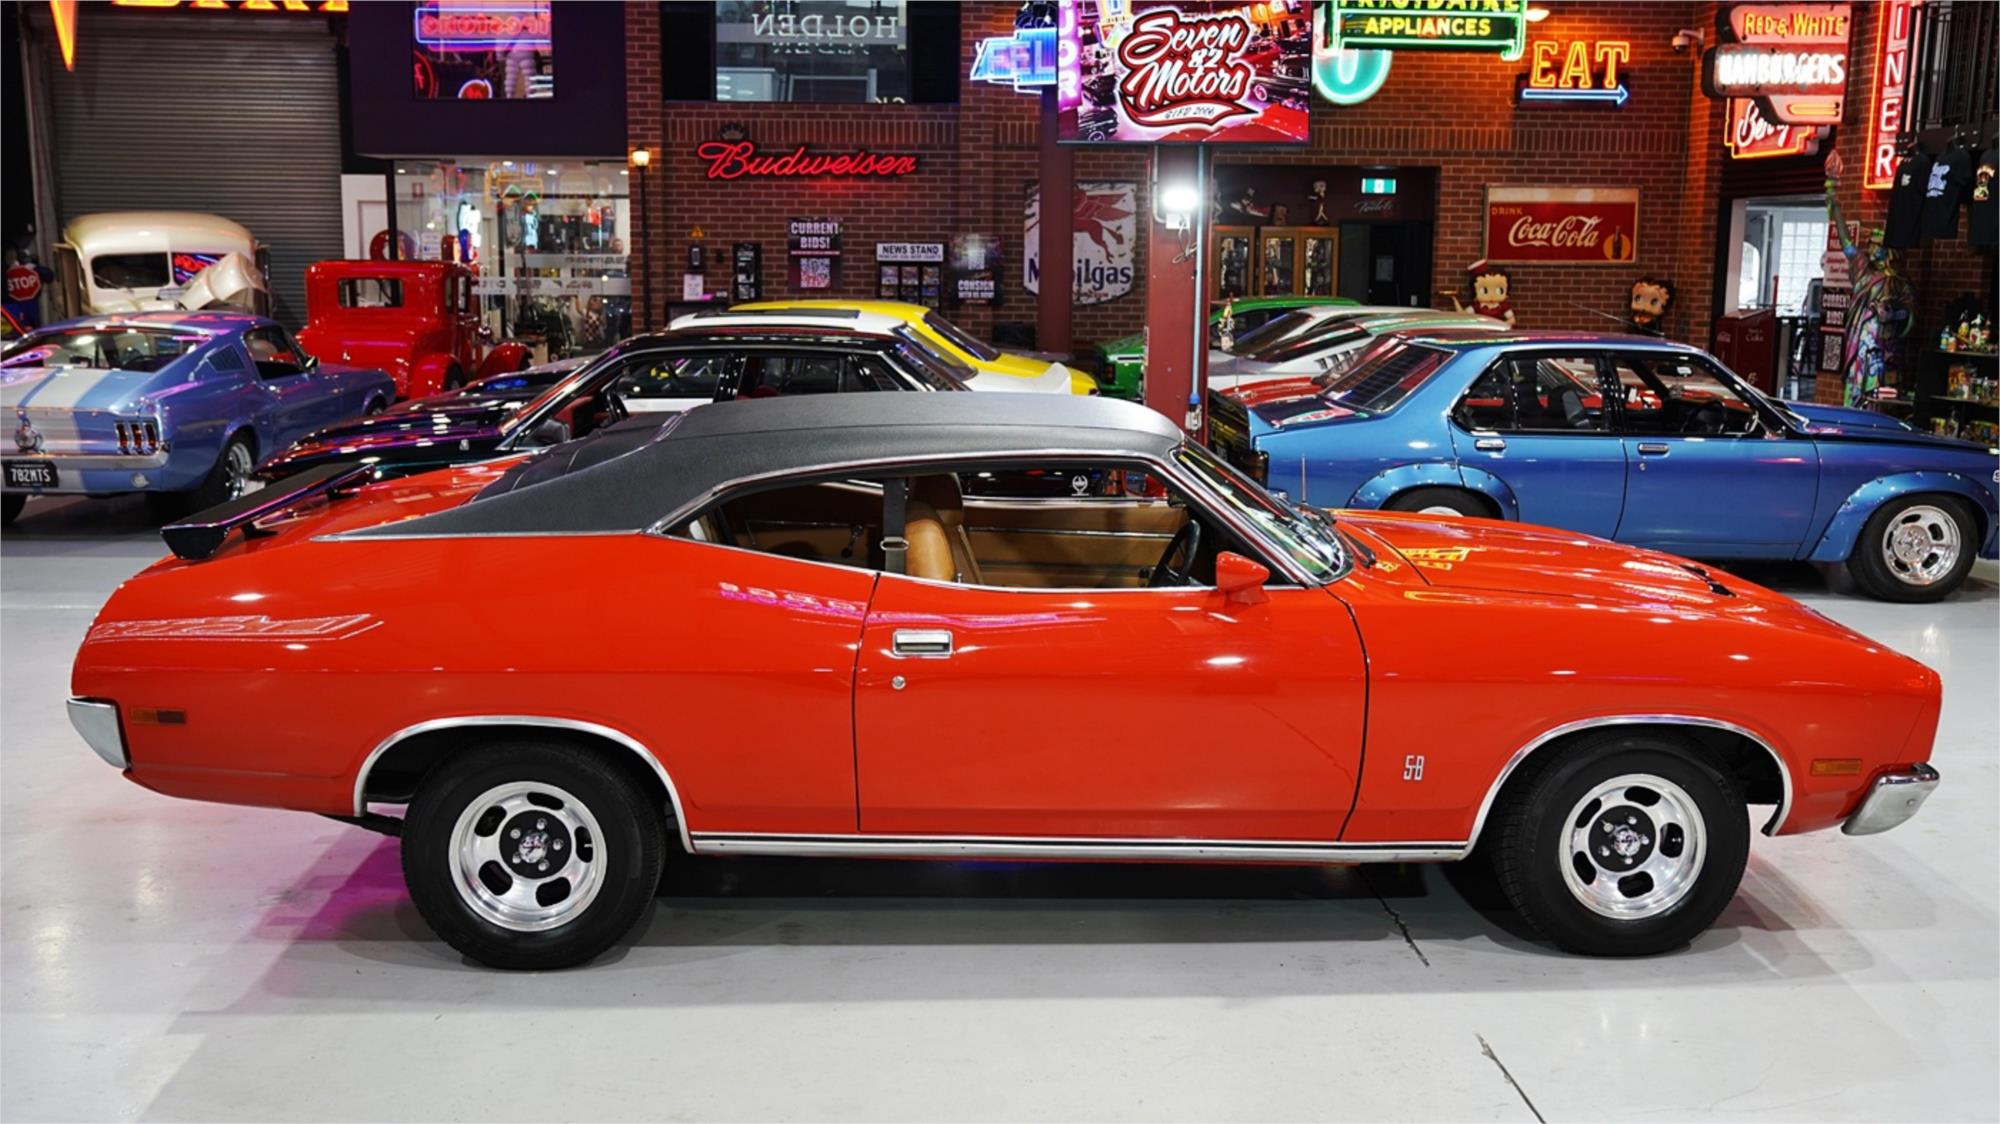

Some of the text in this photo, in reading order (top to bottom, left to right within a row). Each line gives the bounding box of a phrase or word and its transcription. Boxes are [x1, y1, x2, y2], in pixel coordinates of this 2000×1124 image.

[1365, 17, 1491, 36] APPLIANCES
[1745, 13, 1774, 35] RED
[1792, 13, 1845, 36] WHITE
[1124, 16, 1241, 64] Seven
[1188, 49, 1223, 68] 82
[1530, 41, 1630, 88] EAT
[1718, 52, 1846, 85] HAMBURGERS
[1126, 60, 1245, 107] Motors
[698, 142, 916, 179] Budweiser
[1491, 207, 1523, 216] DRINK
[791, 222, 838, 234] CURRENT
[1508, 215, 1603, 247] Coca-Cola
[801, 237, 830, 249] BIDS!
[883, 246, 939, 254] NEWS STAND
[1028, 259, 1131, 290] Milgas
[10, 468, 51, 482] 782MTS
